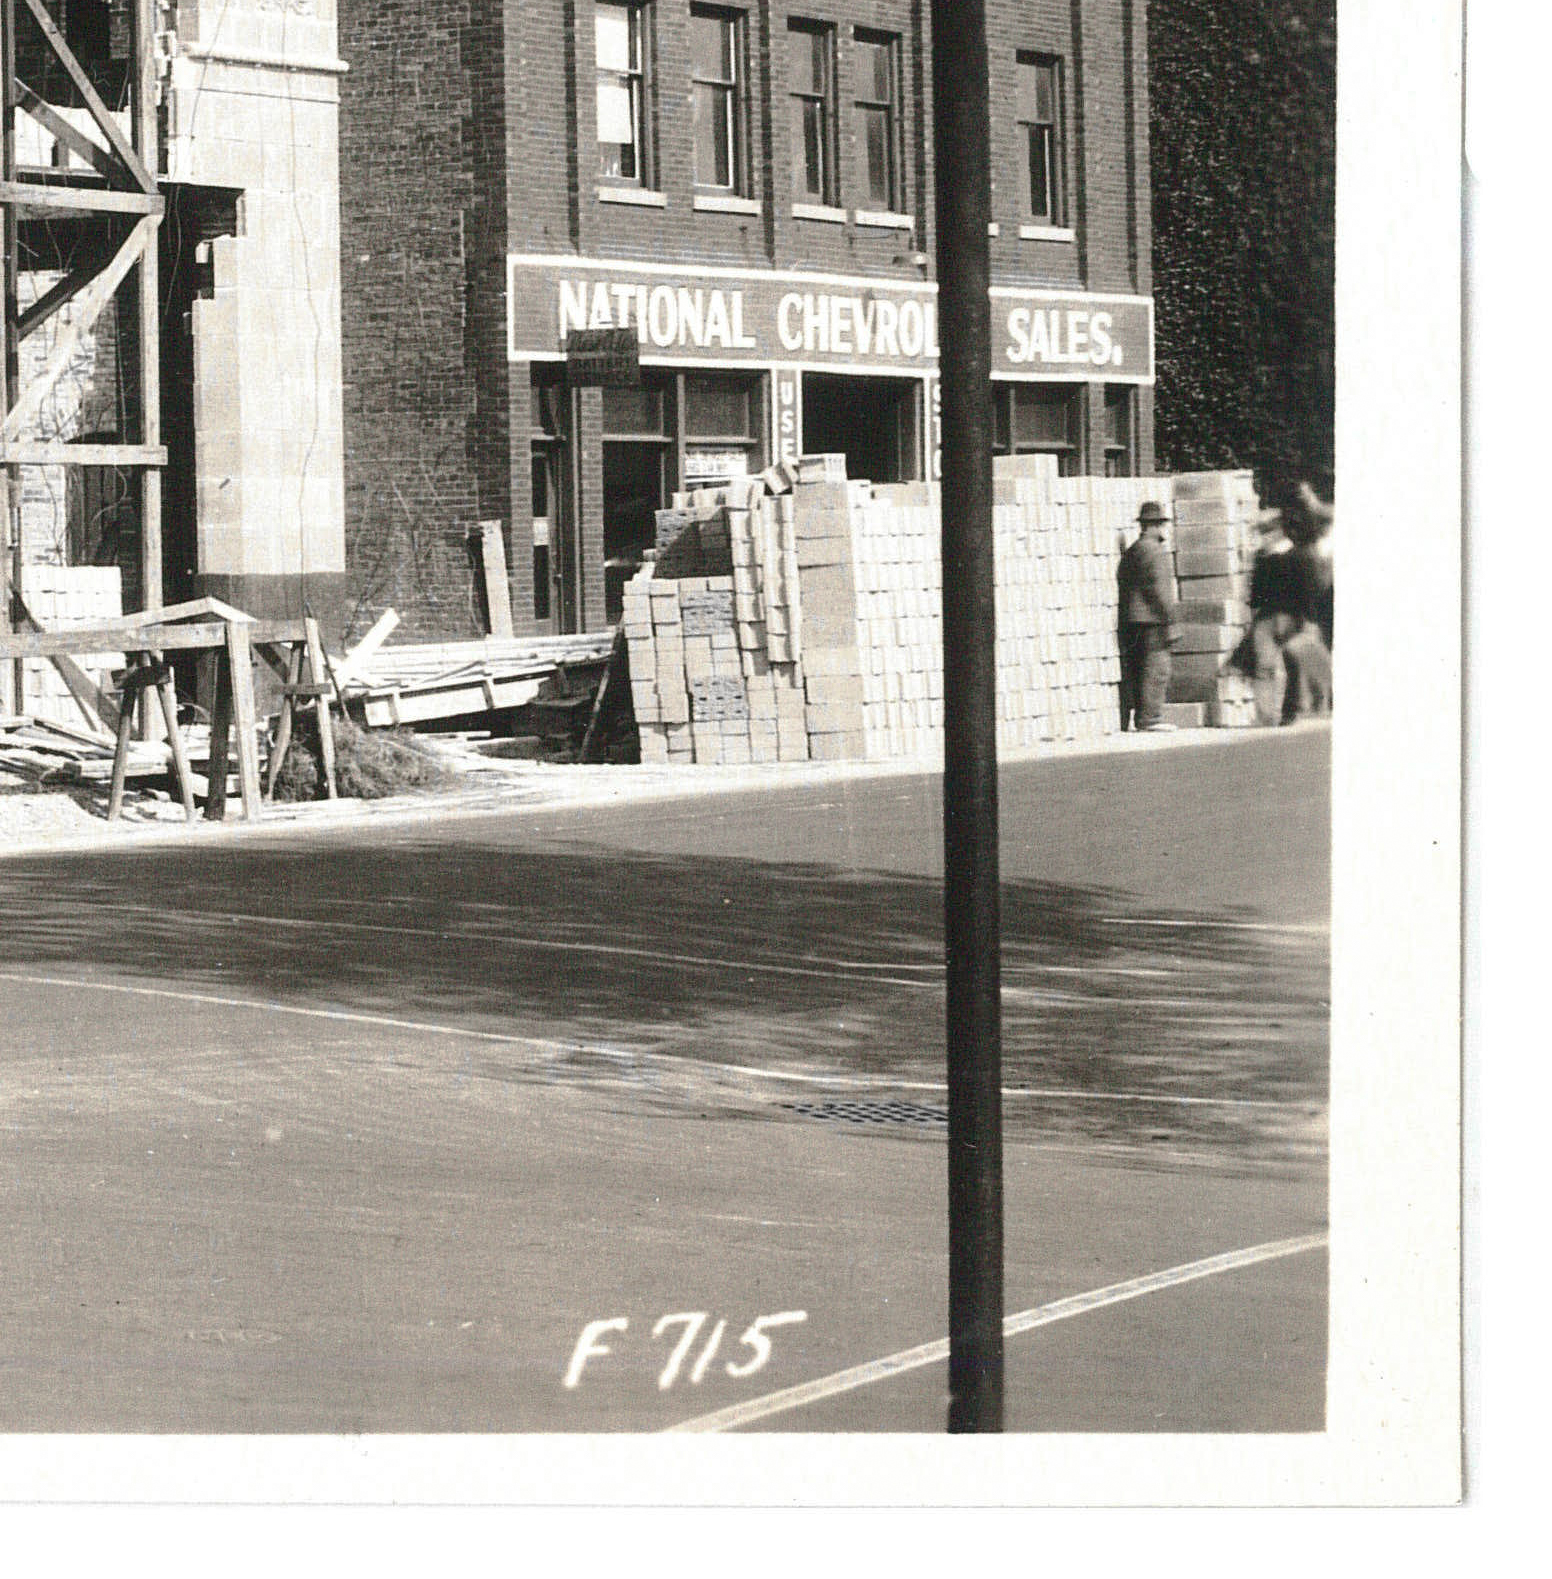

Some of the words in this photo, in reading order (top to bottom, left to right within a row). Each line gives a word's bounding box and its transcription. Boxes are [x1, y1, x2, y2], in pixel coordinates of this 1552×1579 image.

[559, 280, 757, 348] NATIONAL
[777, 293, 942, 358] CHEVROL
[1007, 307, 1123, 367] SALES.
